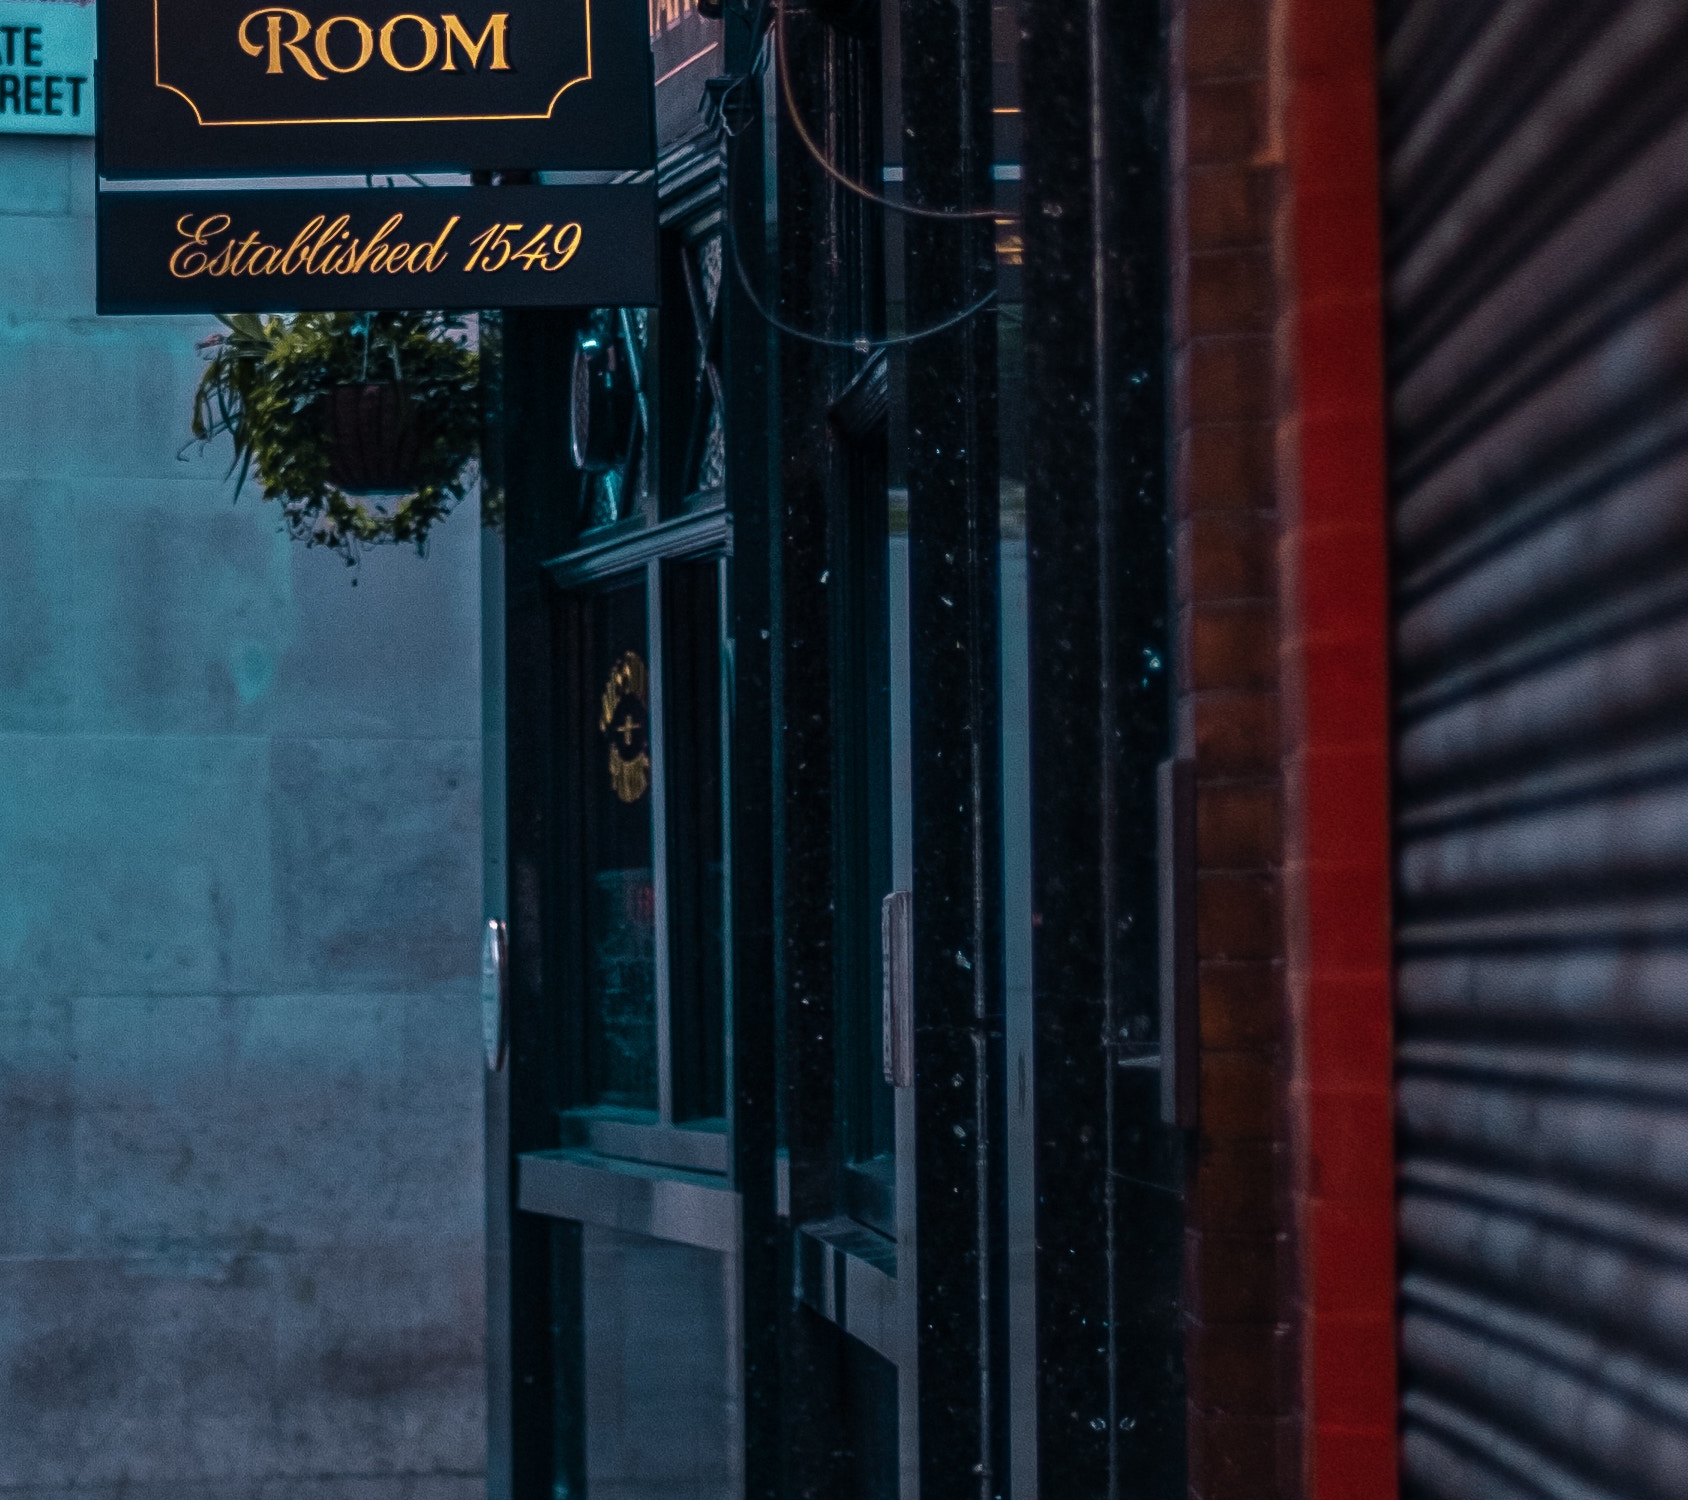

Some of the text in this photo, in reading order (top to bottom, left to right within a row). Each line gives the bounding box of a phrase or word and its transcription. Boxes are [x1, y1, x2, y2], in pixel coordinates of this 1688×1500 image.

[238, 7, 511, 82] ROOM
[170, 213, 583, 279] Established 1549
